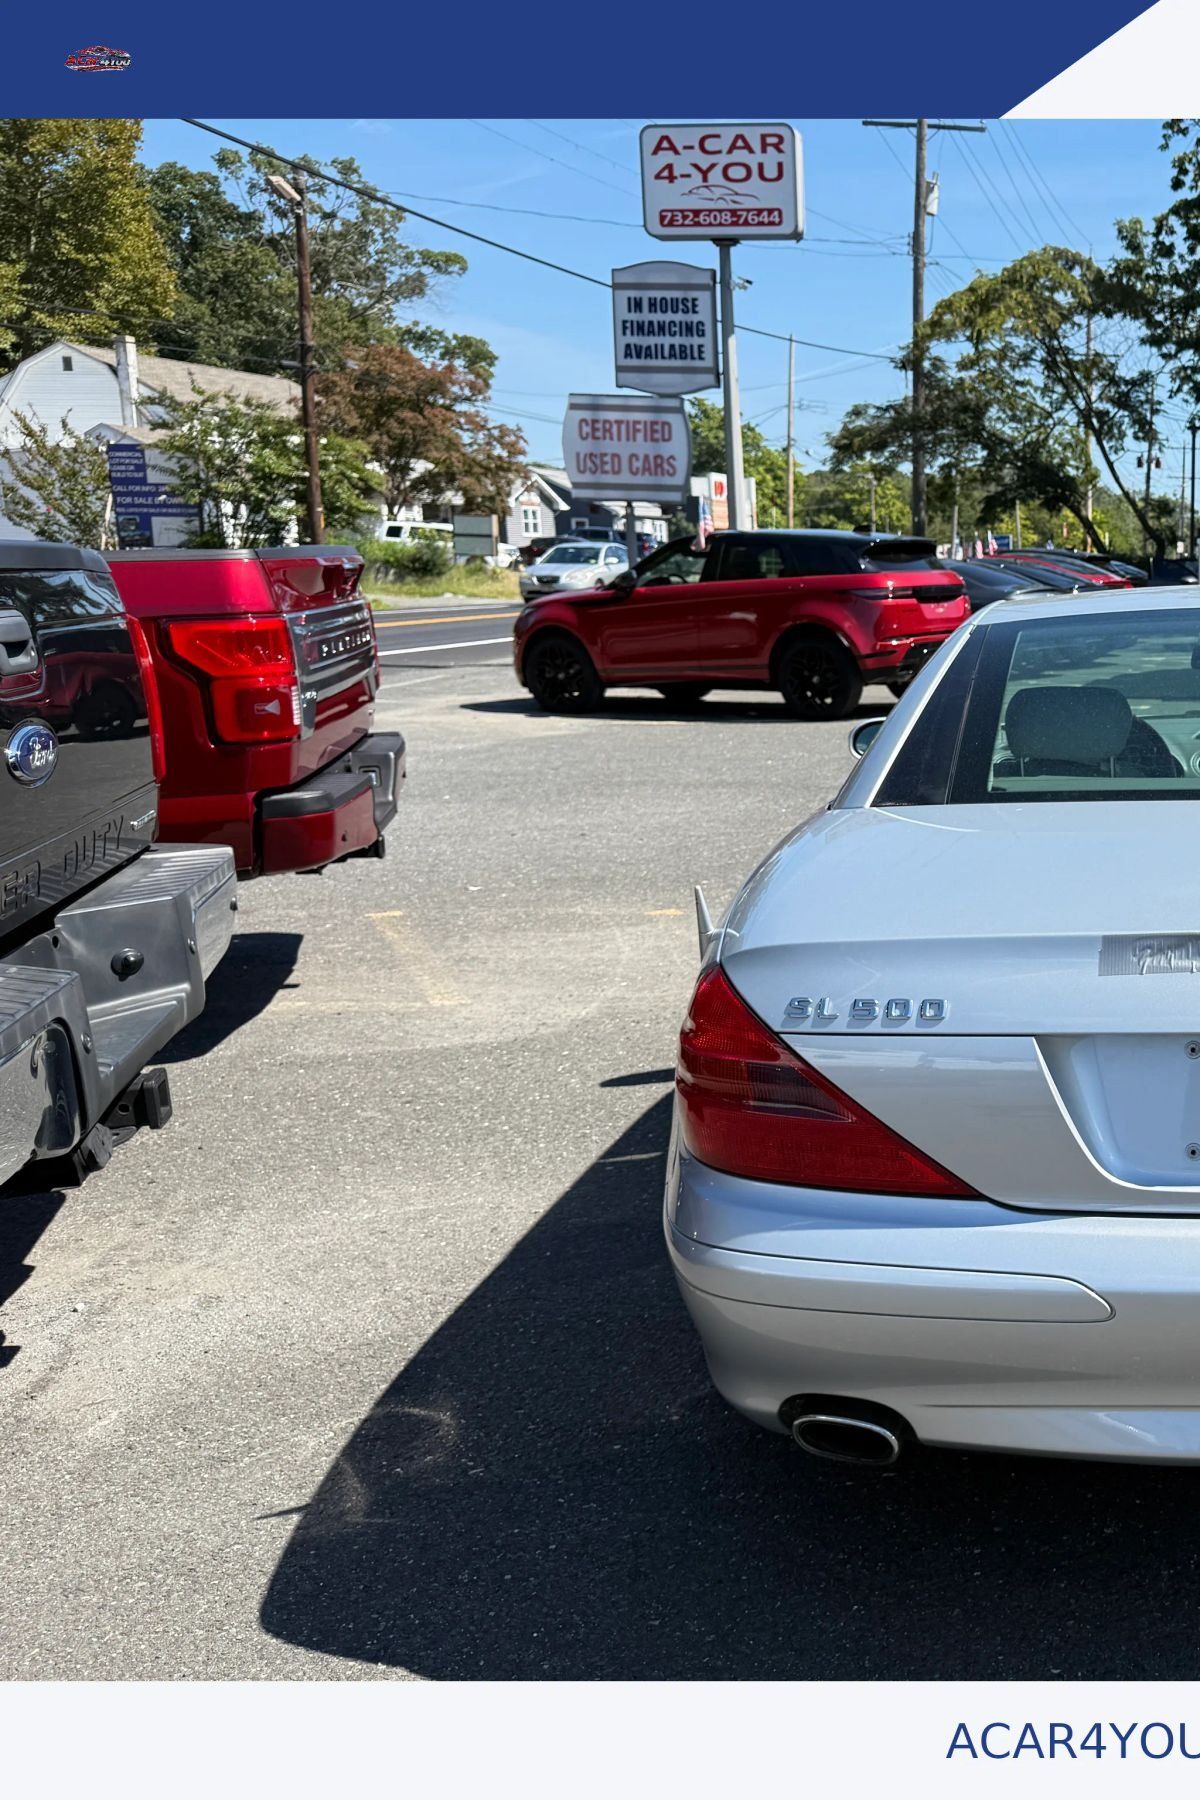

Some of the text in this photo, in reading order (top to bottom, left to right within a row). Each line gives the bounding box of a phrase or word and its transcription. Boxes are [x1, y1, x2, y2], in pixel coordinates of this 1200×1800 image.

[651, 133, 786, 156] A-CAR
[653, 161, 784, 184] 4-YOU
[661, 210, 780, 226] 732-608-7644
[626, 296, 700, 315] IN HOUSE
[621, 319, 706, 338] FINANCING
[623, 342, 706, 361] AVAILABLE
[577, 418, 673, 444] CERTIFIED
[575, 451, 677, 478] USED CARS
[63, 814, 124, 882] DUTY
[784, 996, 948, 1020] SL 500
